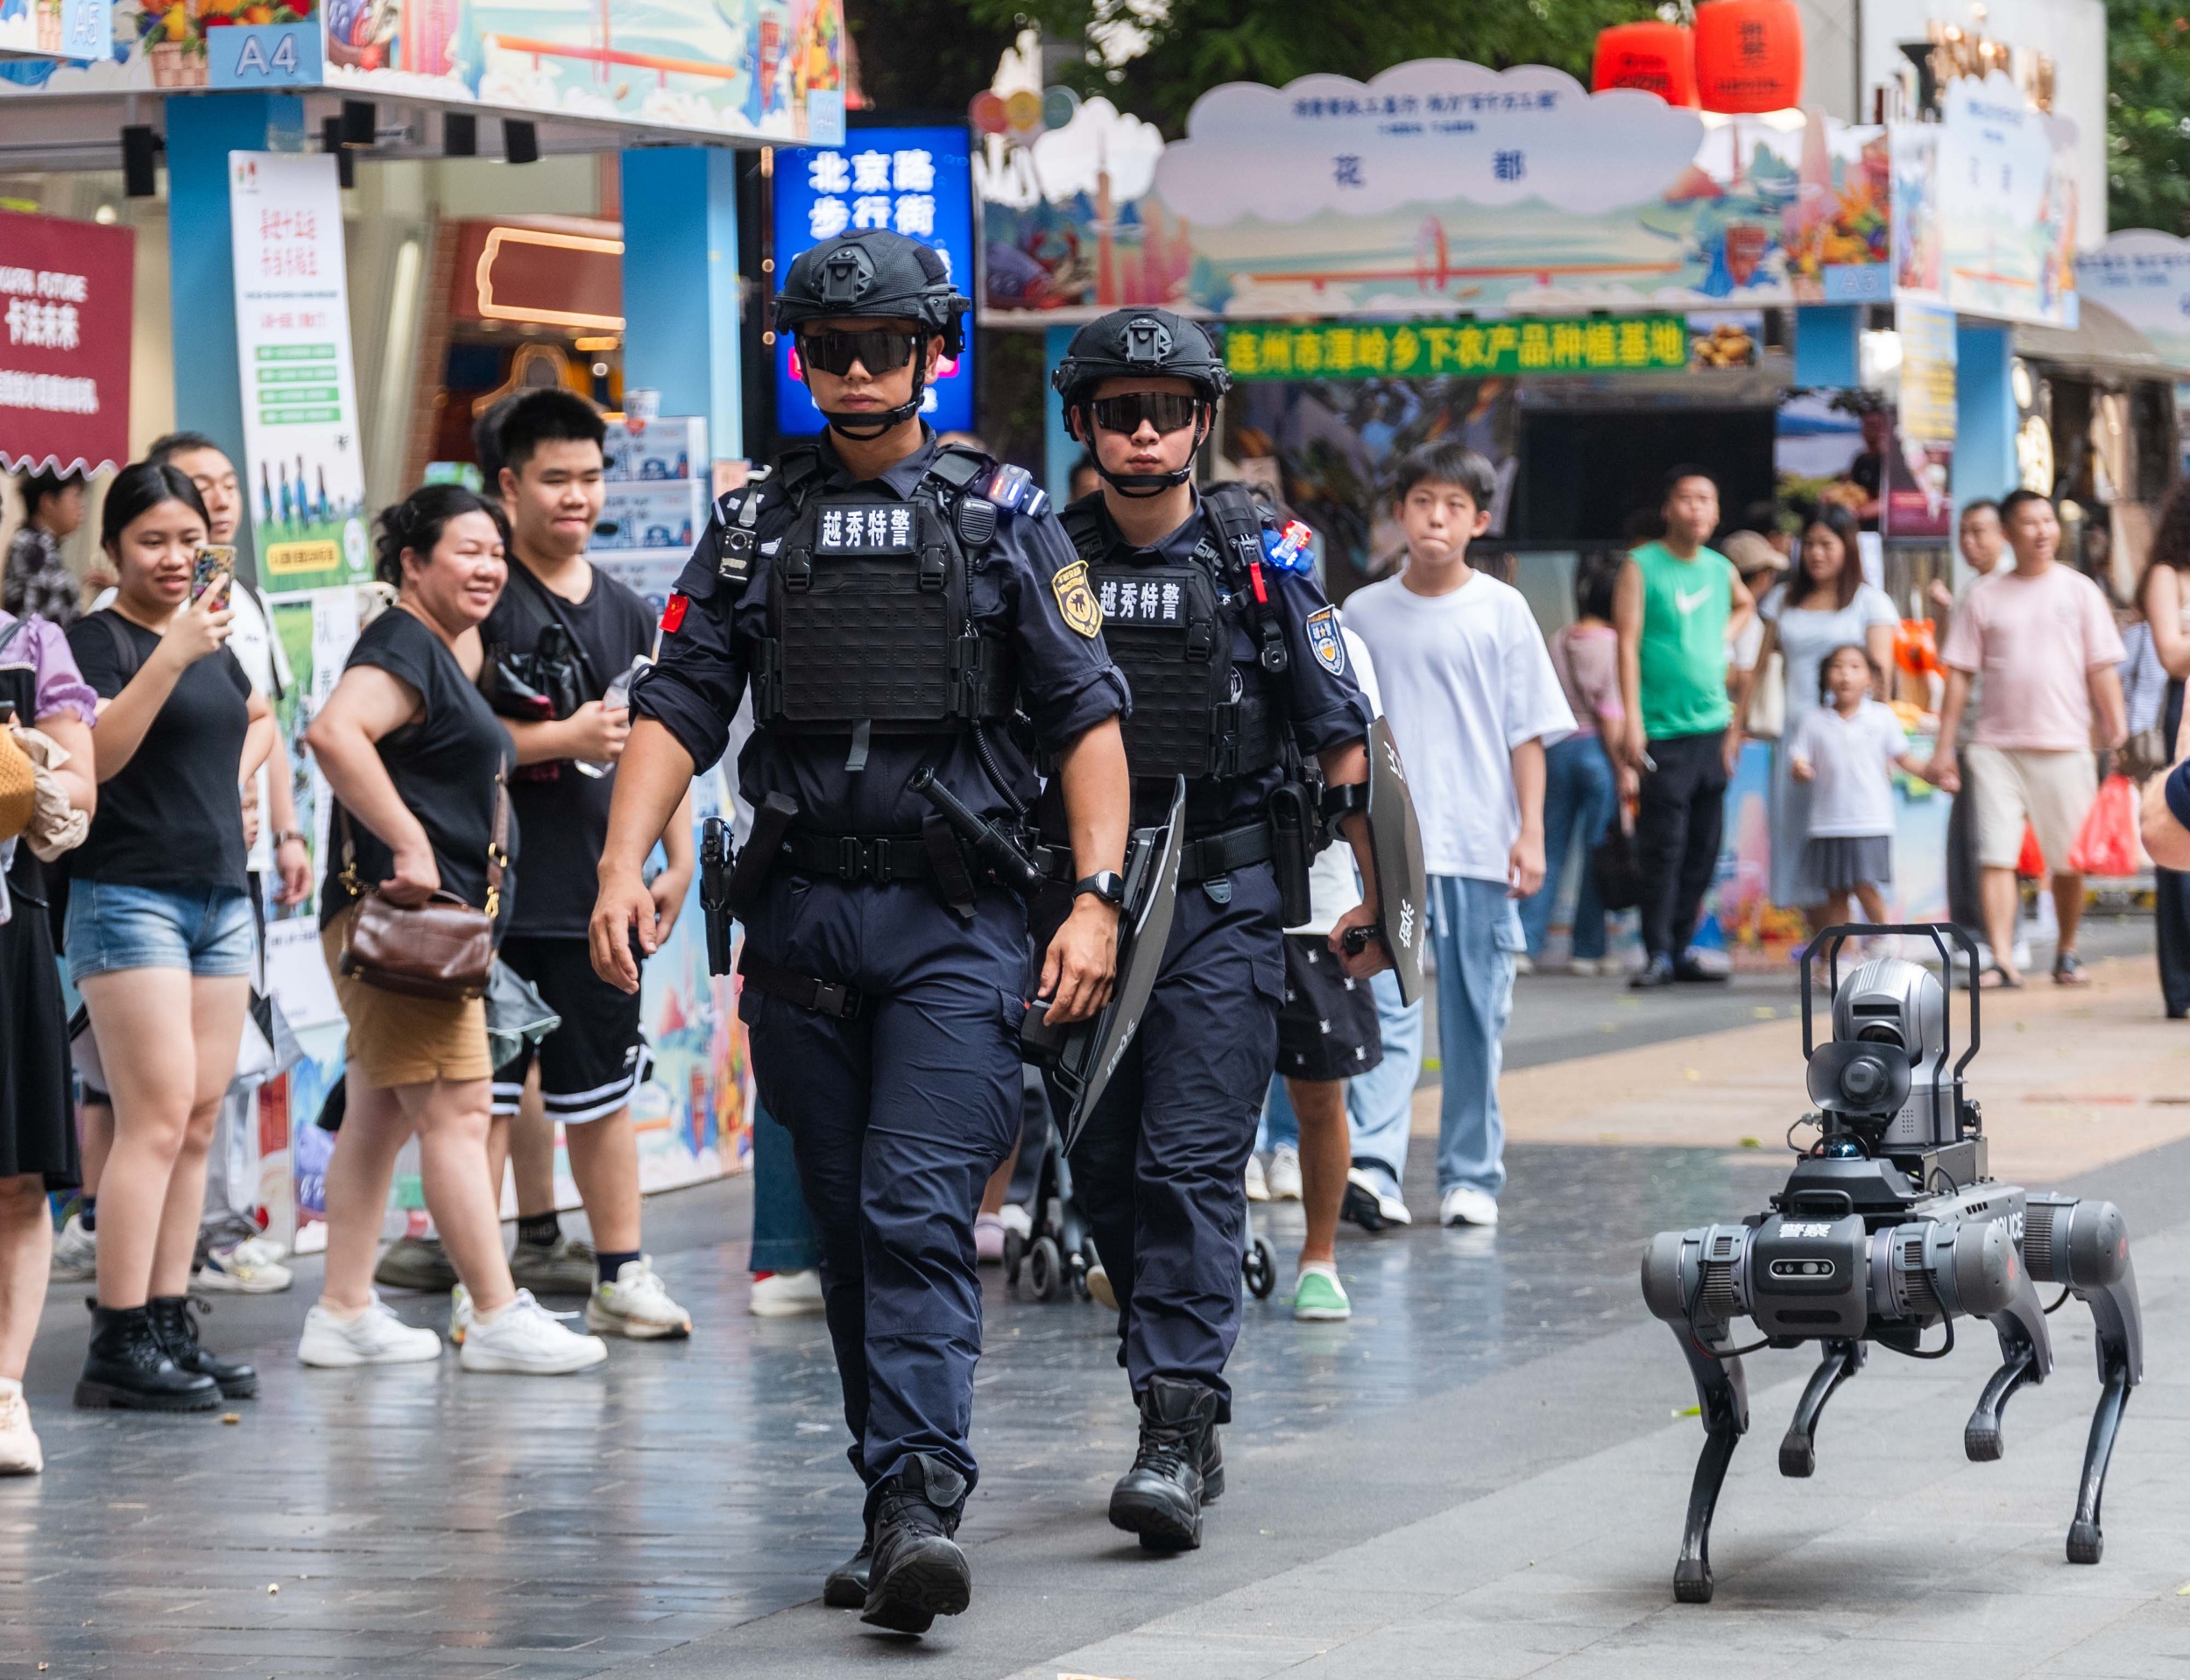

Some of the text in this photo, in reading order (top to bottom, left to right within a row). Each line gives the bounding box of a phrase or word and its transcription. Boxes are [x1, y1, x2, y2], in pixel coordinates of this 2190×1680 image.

[235, 33, 299, 77] A4
[809, 149, 936, 194] 北京路
[808, 194, 936, 240] 步行街
[823, 509, 910, 547] 越秀特警
[1100, 581, 1181, 620] 越秀特警
[1779, 1223, 1832, 1239] 警察
